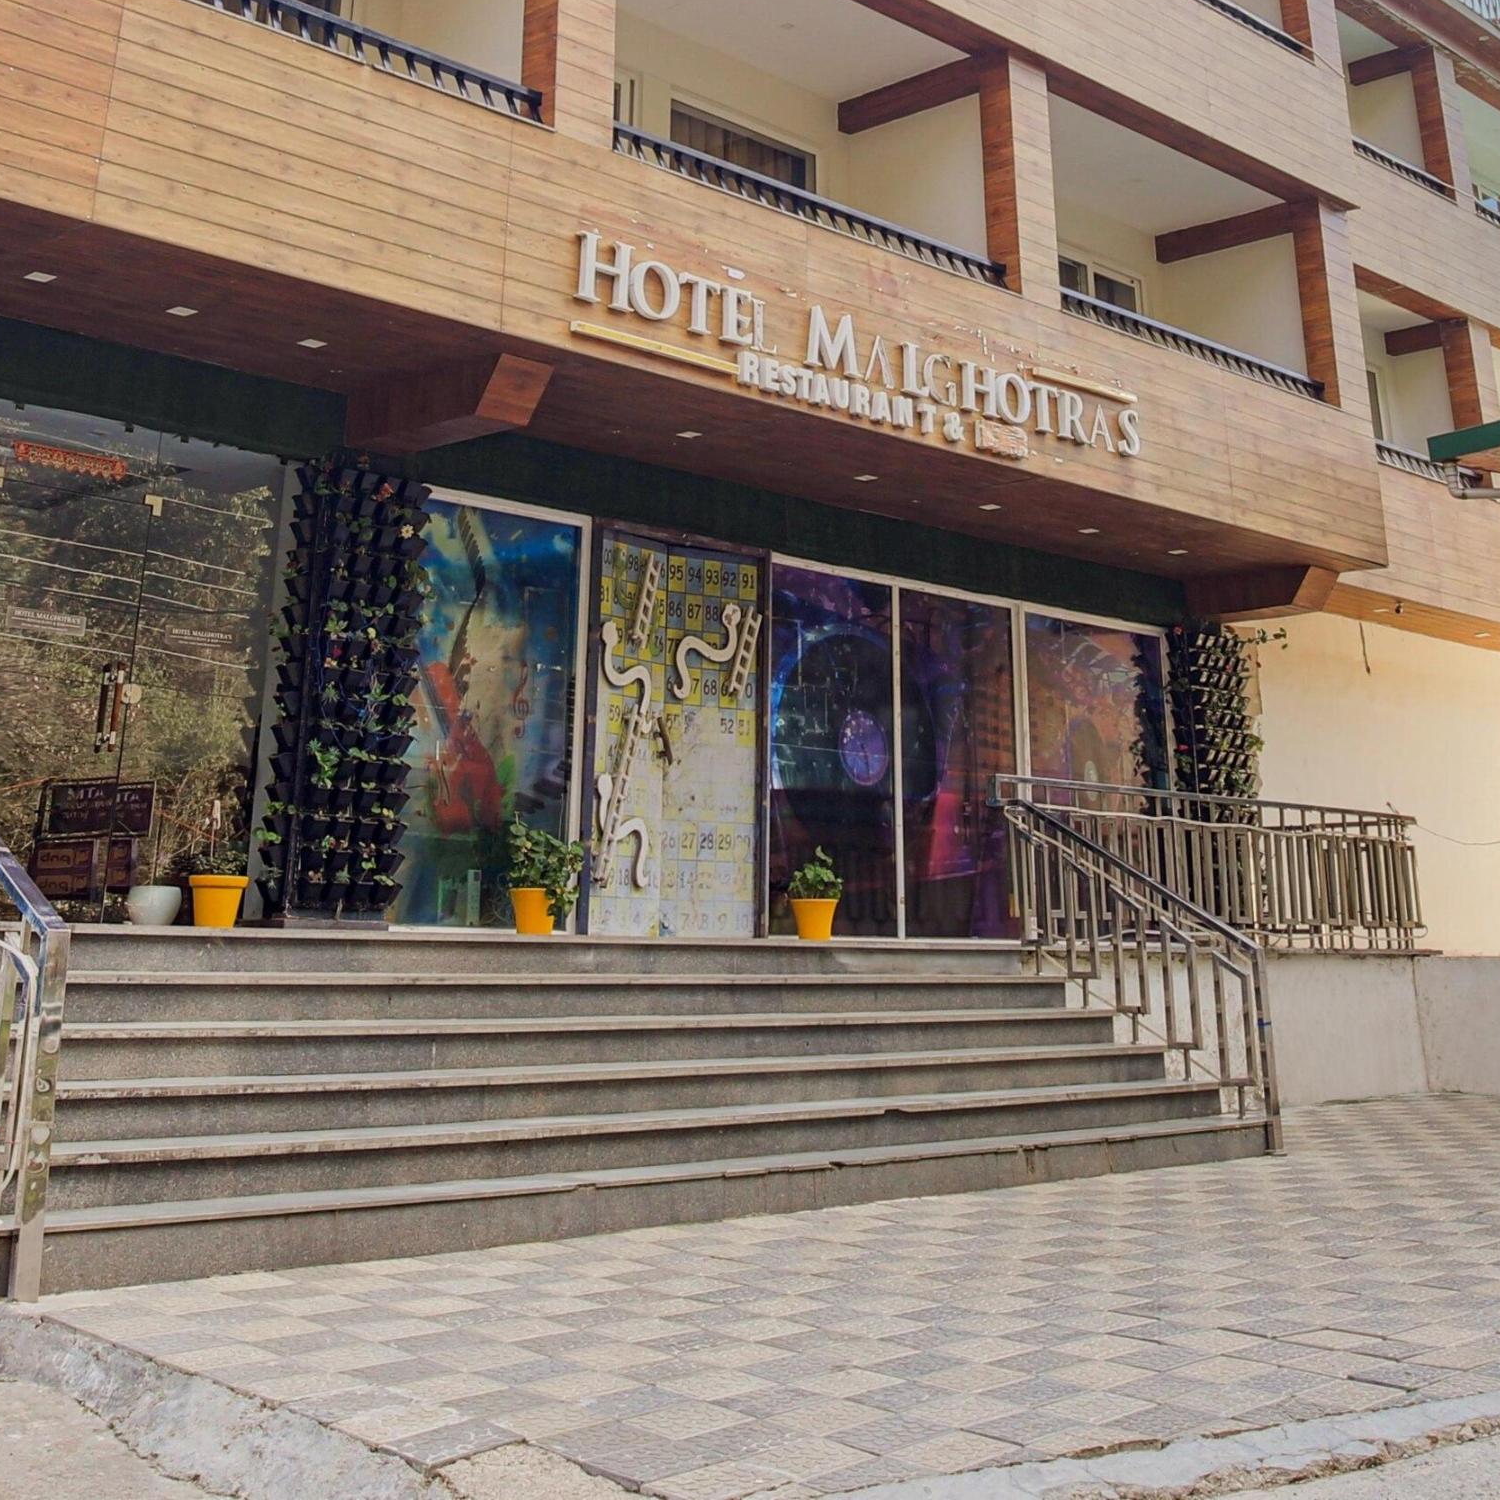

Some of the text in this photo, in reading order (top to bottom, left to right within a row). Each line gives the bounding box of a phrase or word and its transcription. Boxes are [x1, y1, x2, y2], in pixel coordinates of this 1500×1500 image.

[573, 229, 777, 355] HOTEL
[737, 351, 937, 436] RESTAURANT
[944, 411, 965, 443] &
[628, 554, 639, 572] 98
[669, 564, 683, 581] 95
[688, 566, 701, 583] 94
[705, 568, 720, 586] 93
[723, 571, 737, 587] 92
[742, 573, 754, 589] 91
[15, 610, 35, 618] HOTEL
[669, 601, 682, 618] 86
[688, 603, 701, 619] 87
[705, 605, 719, 621] 88
[172, 628, 191, 636] HOTEL
[703, 679, 717, 696] 68
[721, 719, 734, 734] 52
[682, 832, 696, 849] 27
[700, 832, 714, 850] 28
[718, 834, 732, 850] 29
[619, 868, 629, 886] 18
